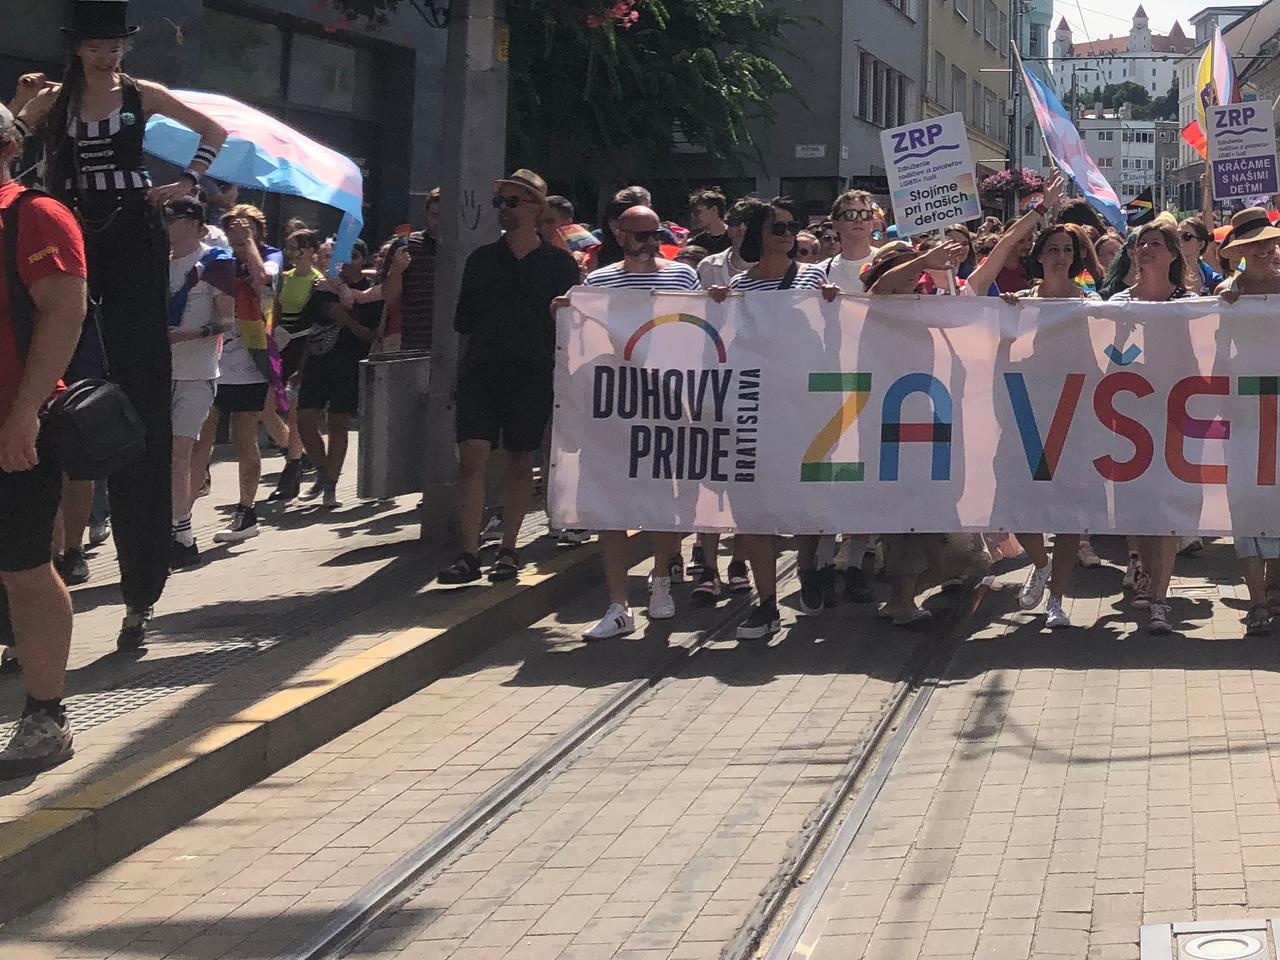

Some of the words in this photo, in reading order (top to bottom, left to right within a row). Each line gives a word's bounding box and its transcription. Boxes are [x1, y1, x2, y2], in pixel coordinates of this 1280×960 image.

[1215, 107, 1255, 128] ZRP
[891, 124, 943, 153] ZRP
[1218, 159, 1271, 172] KRÁČAME
[1222, 175, 1229, 184] S
[1232, 170, 1268, 183] NAŠIMI
[910, 183, 958, 201] Stojíme
[1230, 183, 1263, 194] DEŤMI
[904, 203, 921, 218] pri
[925, 192, 968, 211] našich
[914, 206, 963, 226] deťoch
[735, 368, 761, 482] BRATISLAVA
[800, 372, 952, 482] ZA
[629, 425, 730, 481] PRIDE
